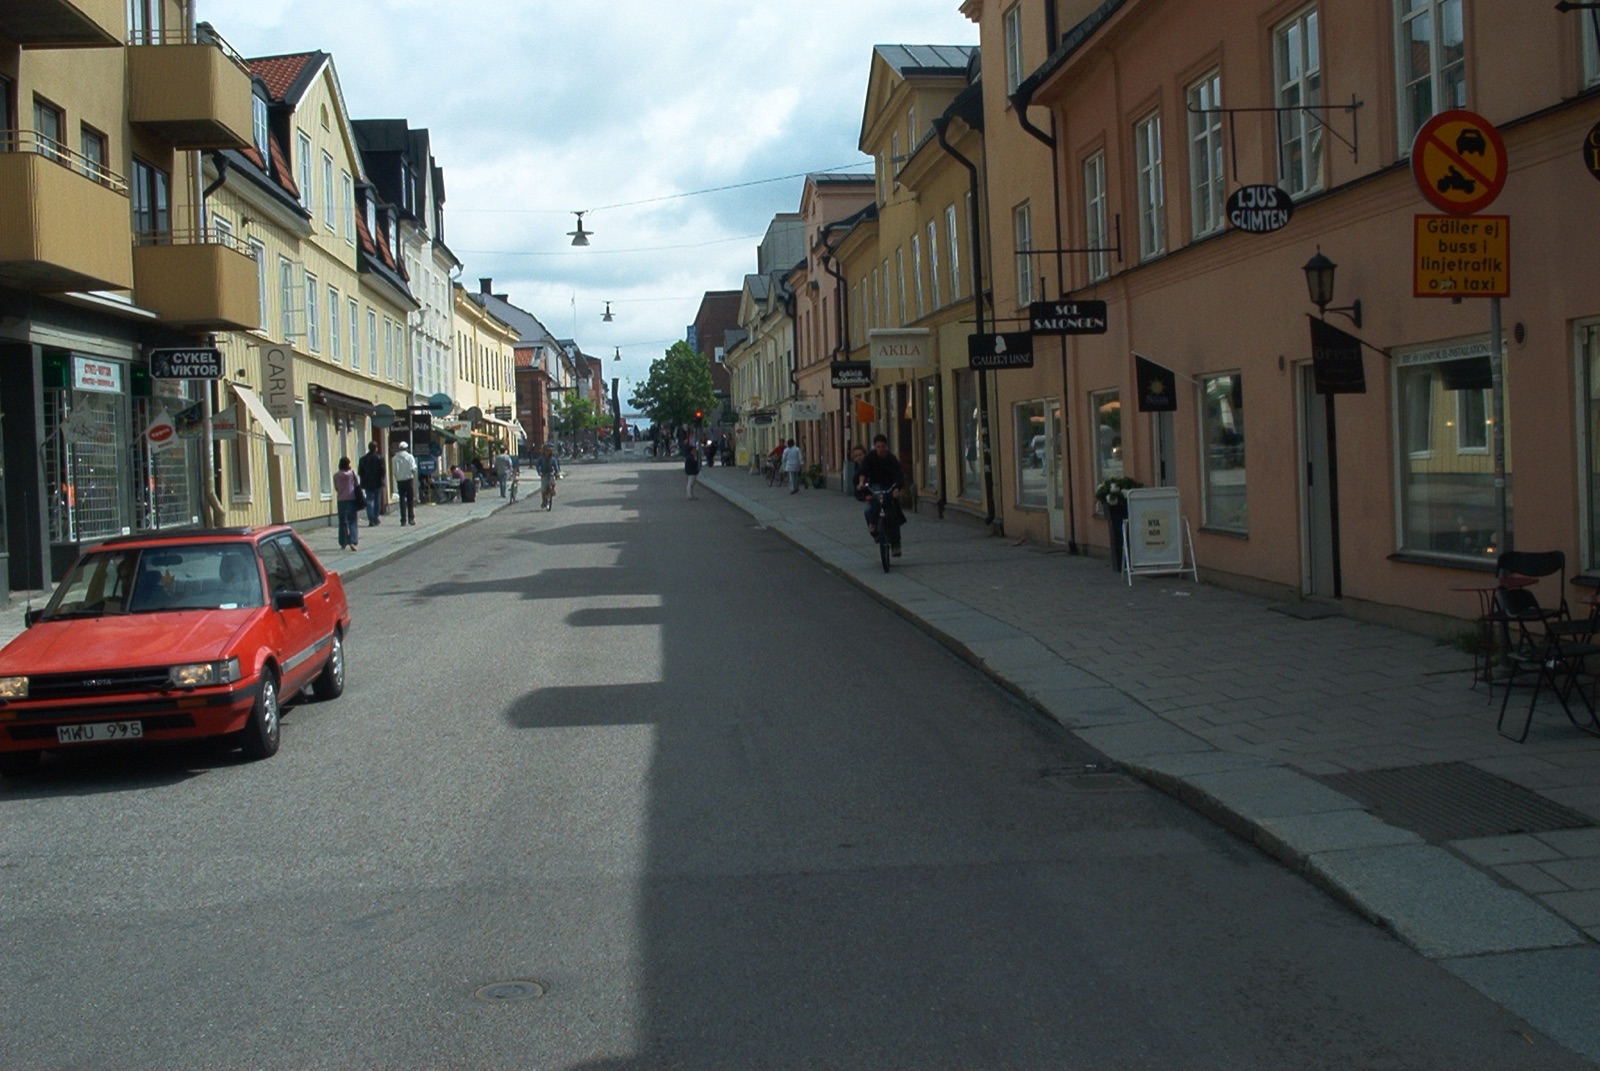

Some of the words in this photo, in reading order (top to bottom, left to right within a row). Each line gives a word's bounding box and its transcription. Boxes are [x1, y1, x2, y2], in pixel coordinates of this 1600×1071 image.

[1238, 186, 1278, 208] LJUS
[1231, 209, 1288, 231] GLIMTEN
[1427, 219, 1478, 234] Gäller
[1484, 222, 1499, 239] ej
[1439, 238, 1477, 253] buss
[1482, 240, 1487, 253] i
[1421, 256, 1502, 274] linjetrafik
[1464, 277, 1495, 290] taxi
[1055, 304, 1081, 316] SOL
[1033, 317, 1104, 330] SALONGEN
[879, 344, 921, 357] AKILA
[172, 353, 216, 363] CYKEL
[971, 354, 1008, 366] GALLERI
[1009, 352, 1031, 365] LINNÉ
[171, 365, 218, 376] VIKTOR
[267, 348, 287, 404] CARL
[82, 679, 112, 687] TOYOTA
[60, 725, 95, 741] MWU
[107, 722, 141, 738] 995
